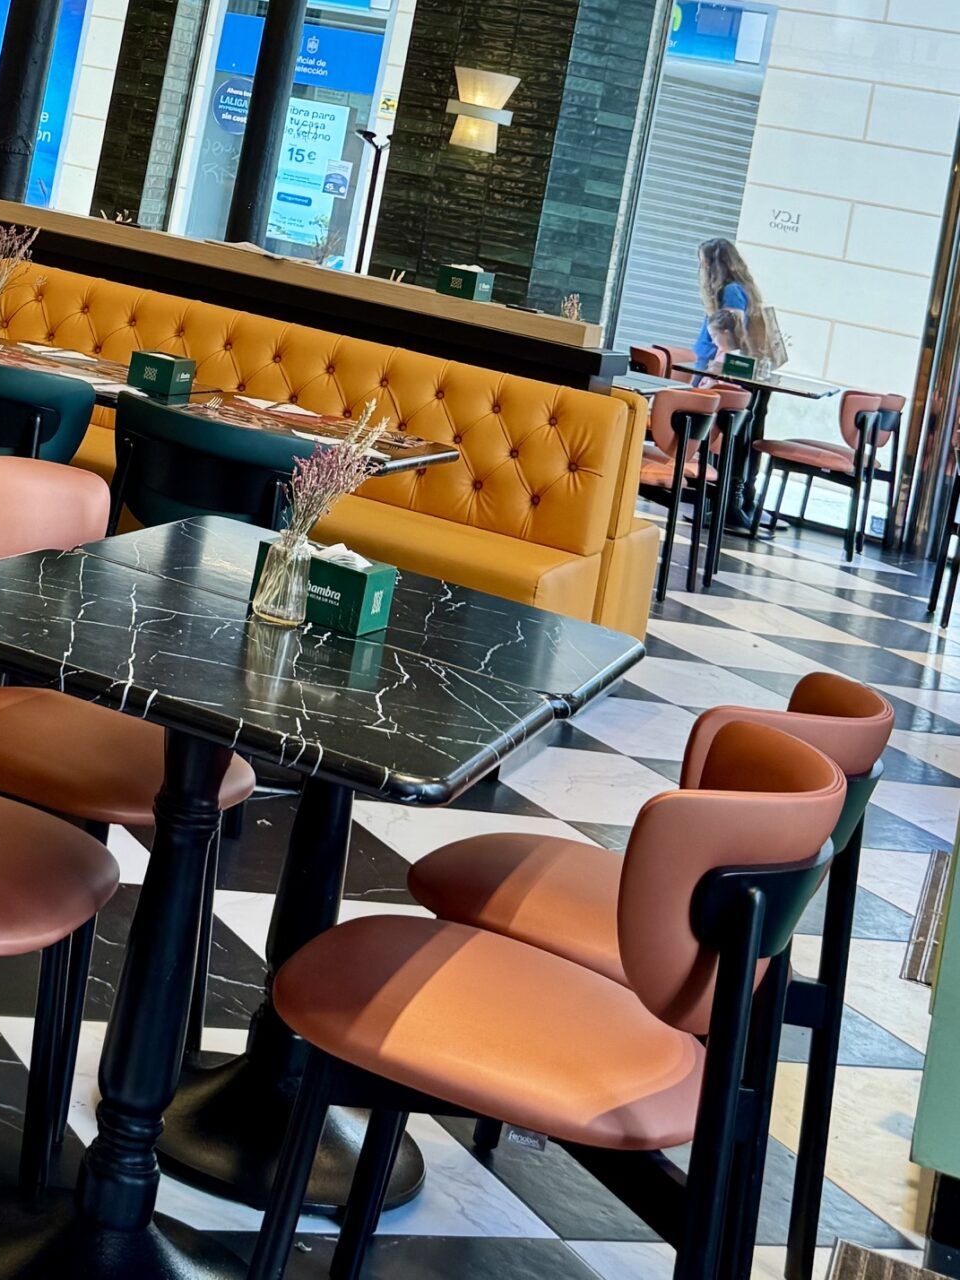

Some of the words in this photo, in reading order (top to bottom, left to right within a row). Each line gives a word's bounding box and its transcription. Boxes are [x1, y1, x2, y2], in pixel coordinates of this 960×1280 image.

[316, 59, 327, 67] de
[219, 95, 248, 108] LALIGA
[221, 111, 232, 120] sin
[311, 111, 336, 122] para
[287, 147, 306, 163] 15
